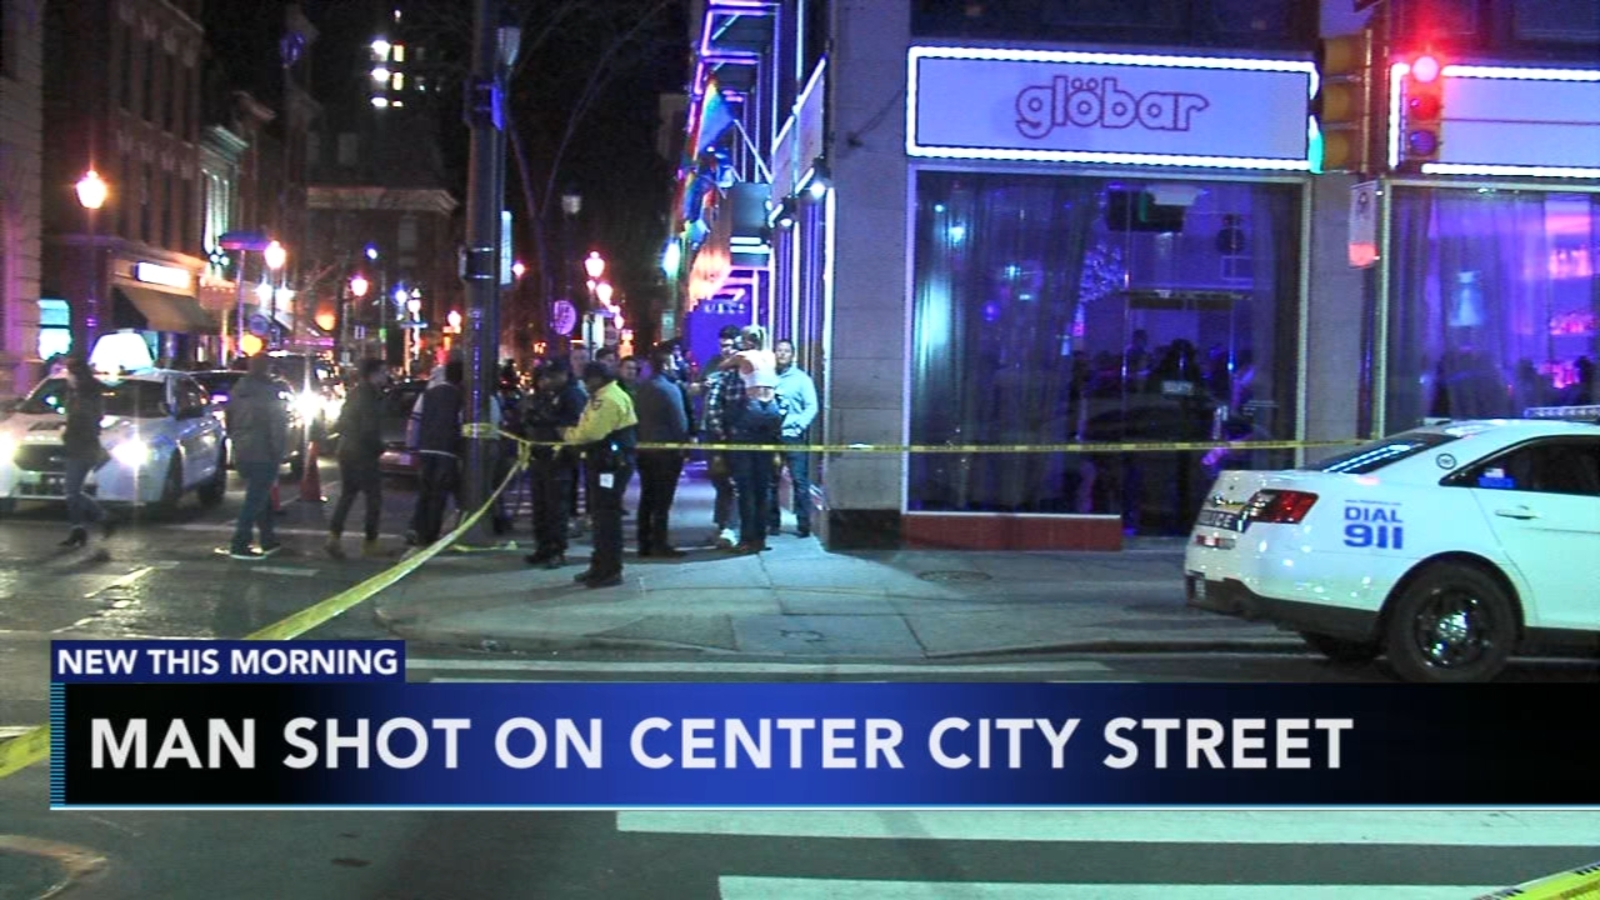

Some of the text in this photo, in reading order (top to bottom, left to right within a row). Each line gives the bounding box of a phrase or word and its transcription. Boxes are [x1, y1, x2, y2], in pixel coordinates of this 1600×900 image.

[1015, 75, 1209, 140] glöbar
[1344, 506, 1403, 523] DIAL
[1344, 524, 1403, 550] 911
